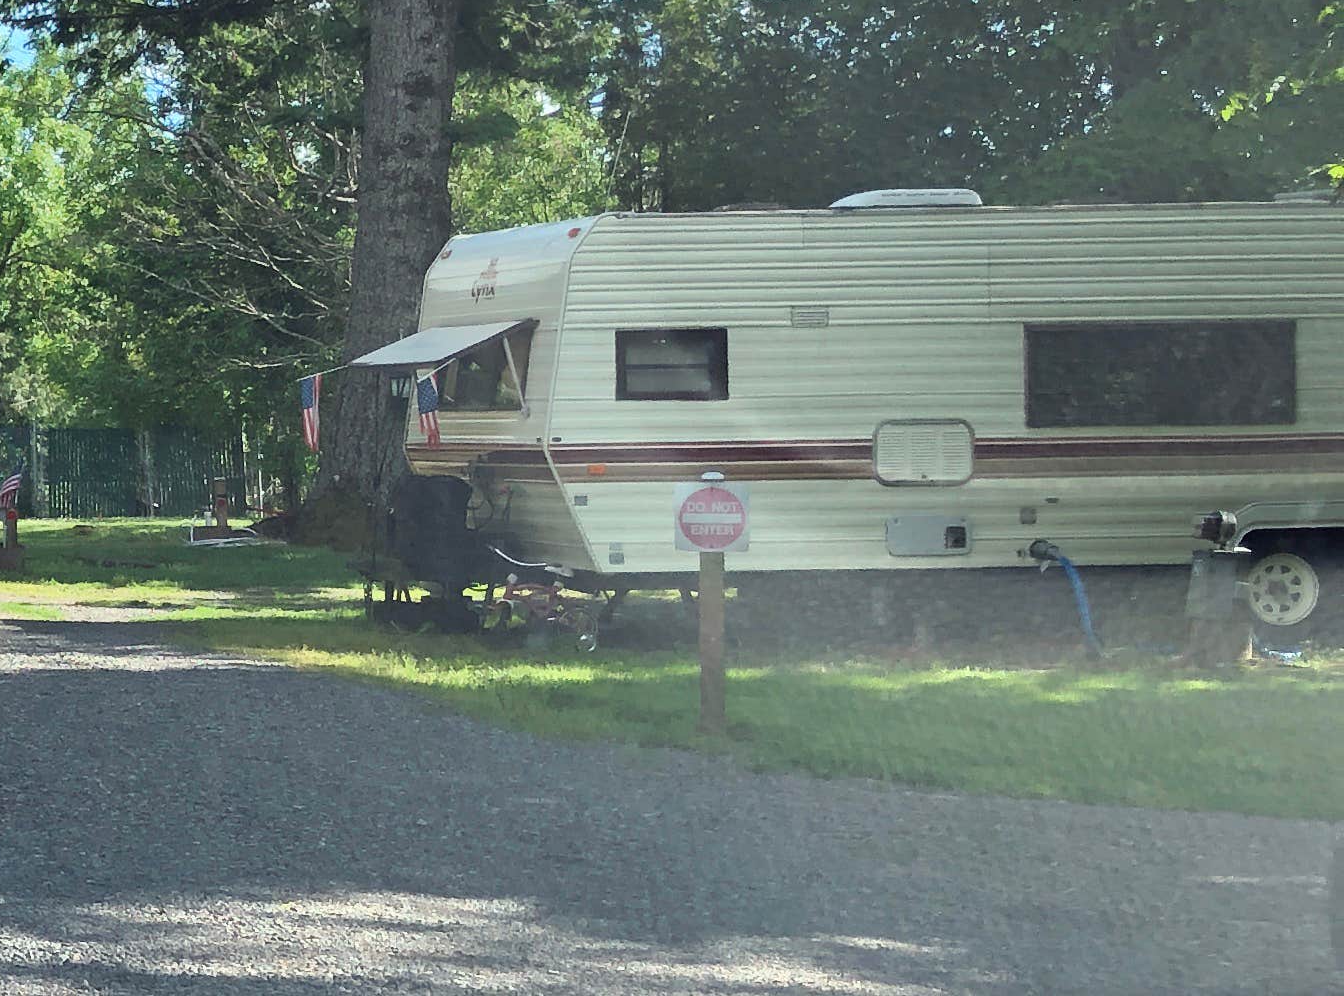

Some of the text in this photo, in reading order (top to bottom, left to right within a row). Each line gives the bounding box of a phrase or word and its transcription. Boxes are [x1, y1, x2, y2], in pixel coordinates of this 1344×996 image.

[687, 501, 739, 512] DO NOT
[691, 524, 734, 535] ENTER
